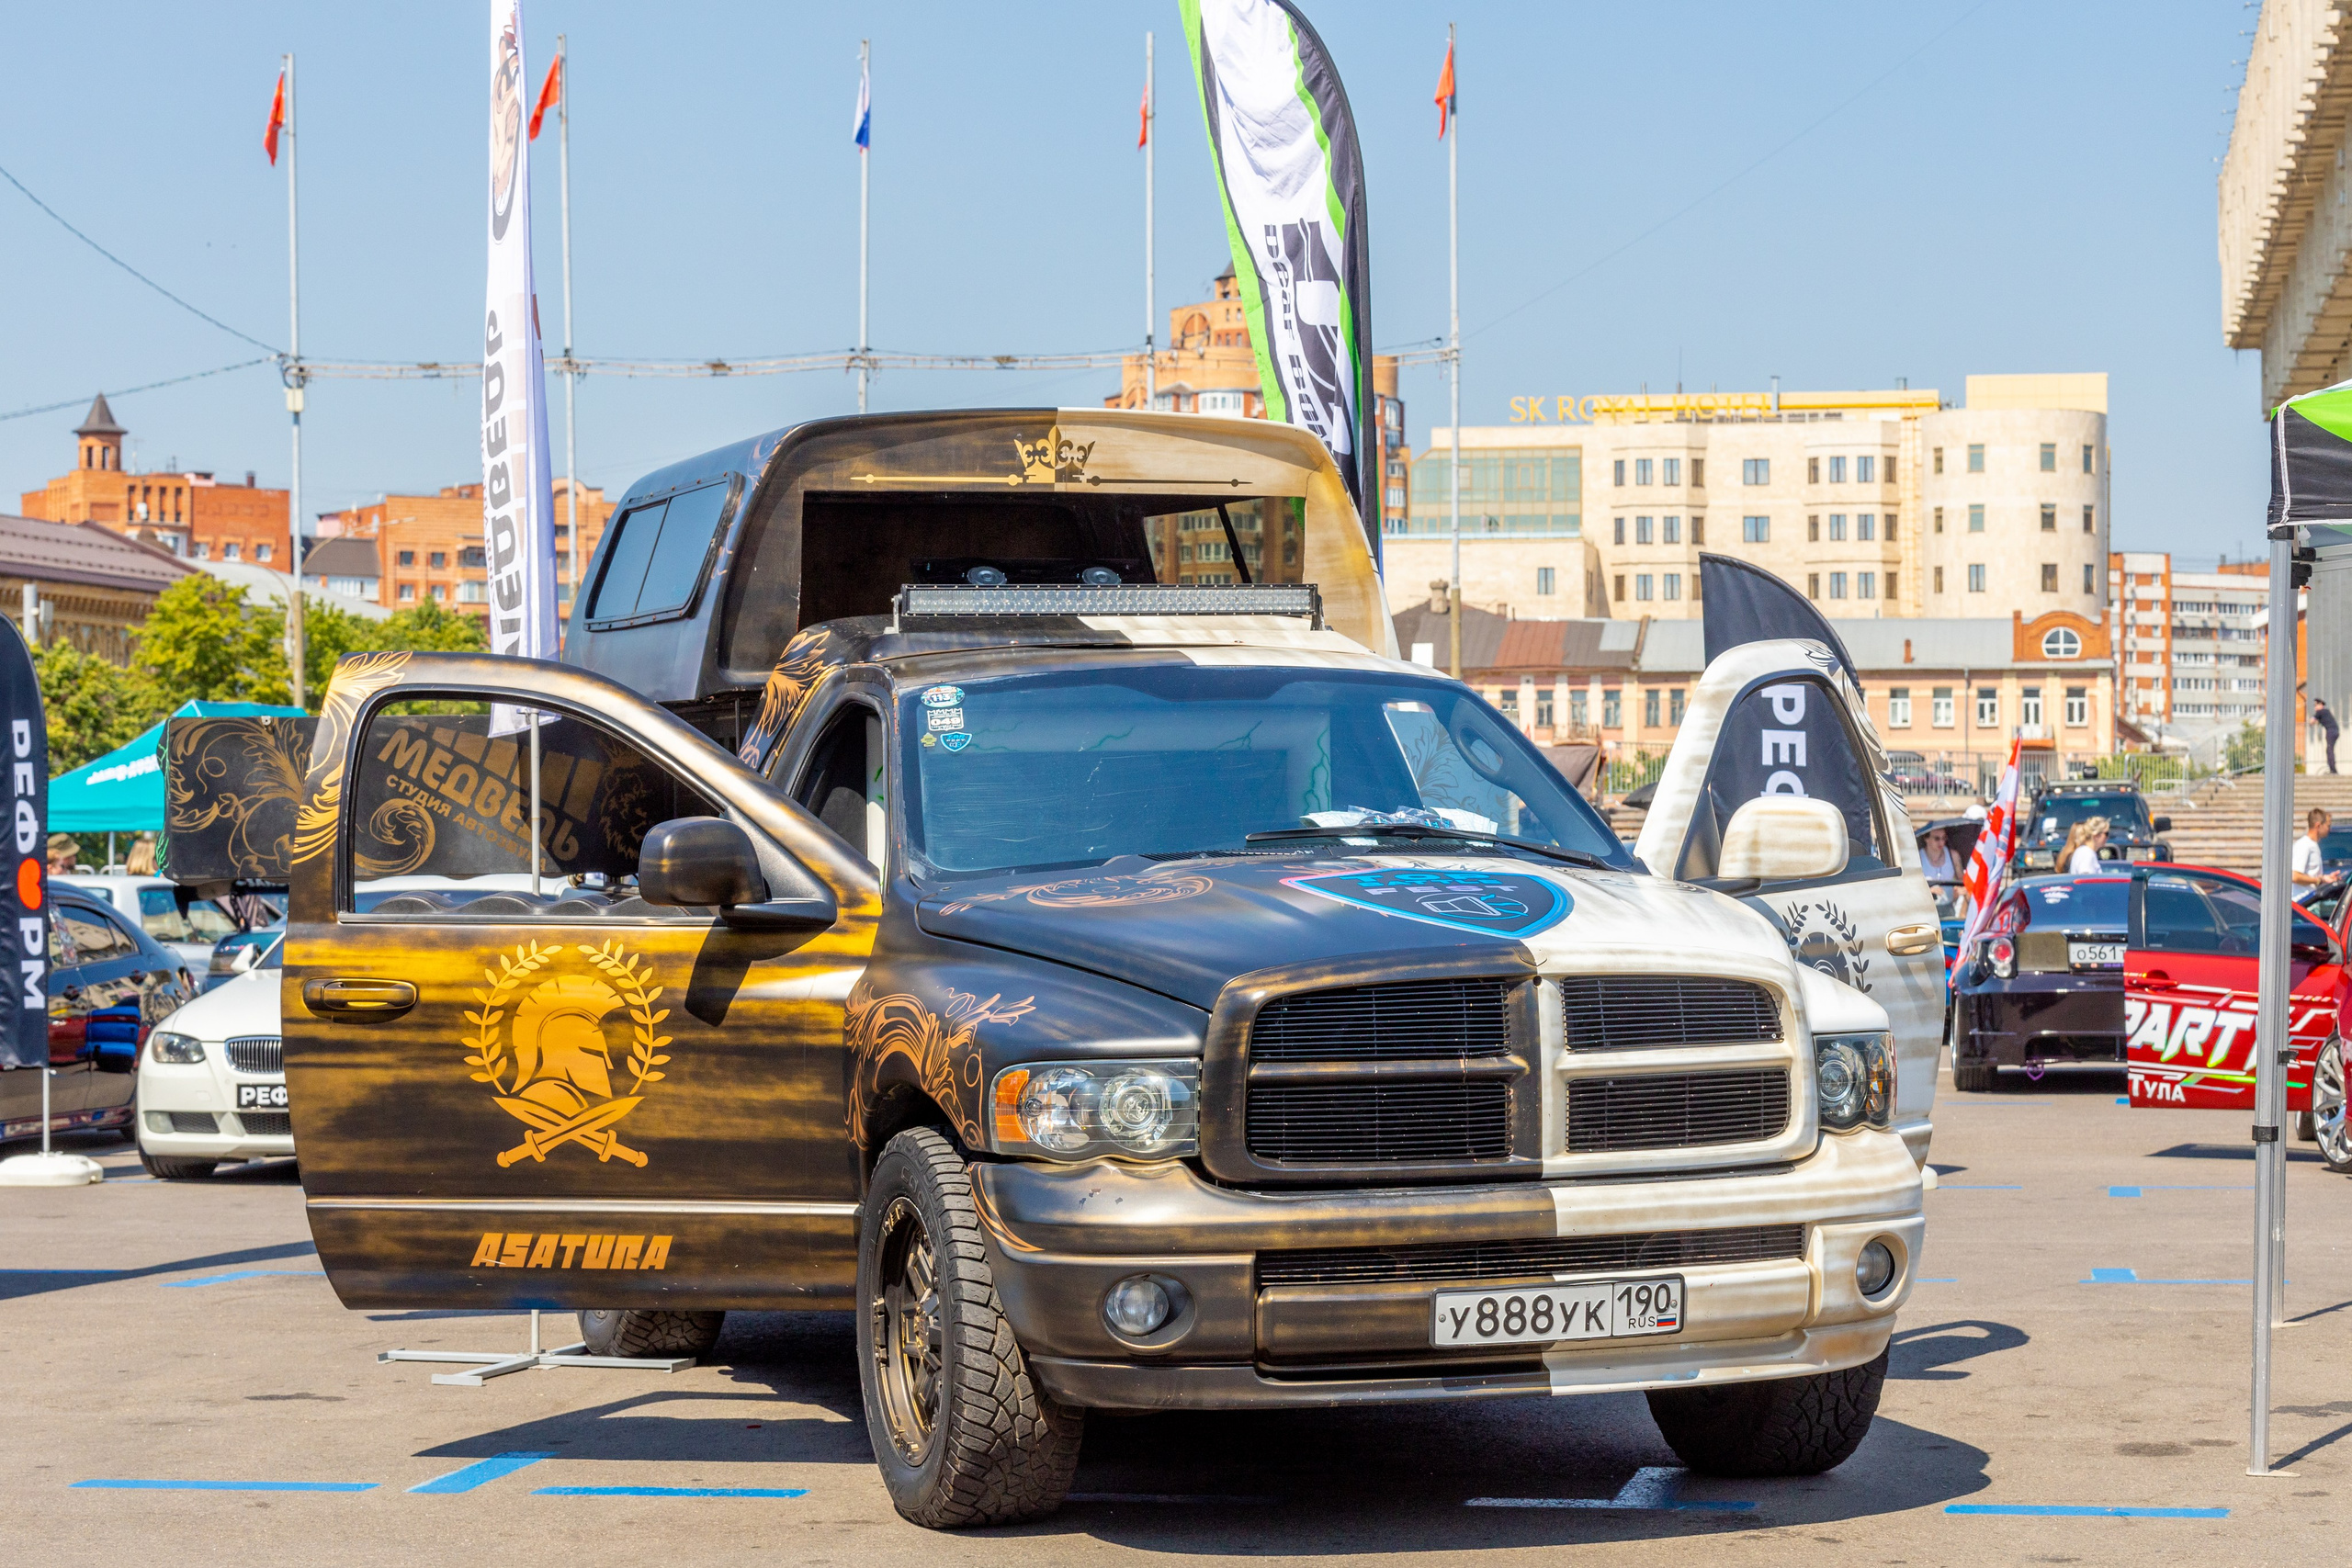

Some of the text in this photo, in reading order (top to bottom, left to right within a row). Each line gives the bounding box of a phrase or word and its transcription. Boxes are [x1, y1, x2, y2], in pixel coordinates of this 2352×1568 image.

[1509, 393, 1776, 423] SK ROYAL HOTEL
[377, 728, 580, 862] МЕДВЕДЬ
[386, 774, 452, 818] СТУДИЯ
[1339, 874, 1490, 884] TOP
[1364, 885, 1519, 896] FEST
[2124, 998, 2258, 1072] PART
[469, 1232, 673, 1270] ASATURA
[1449, 1282, 1671, 1339] У888УК 190
[1628, 1315, 1656, 1329] RUS
